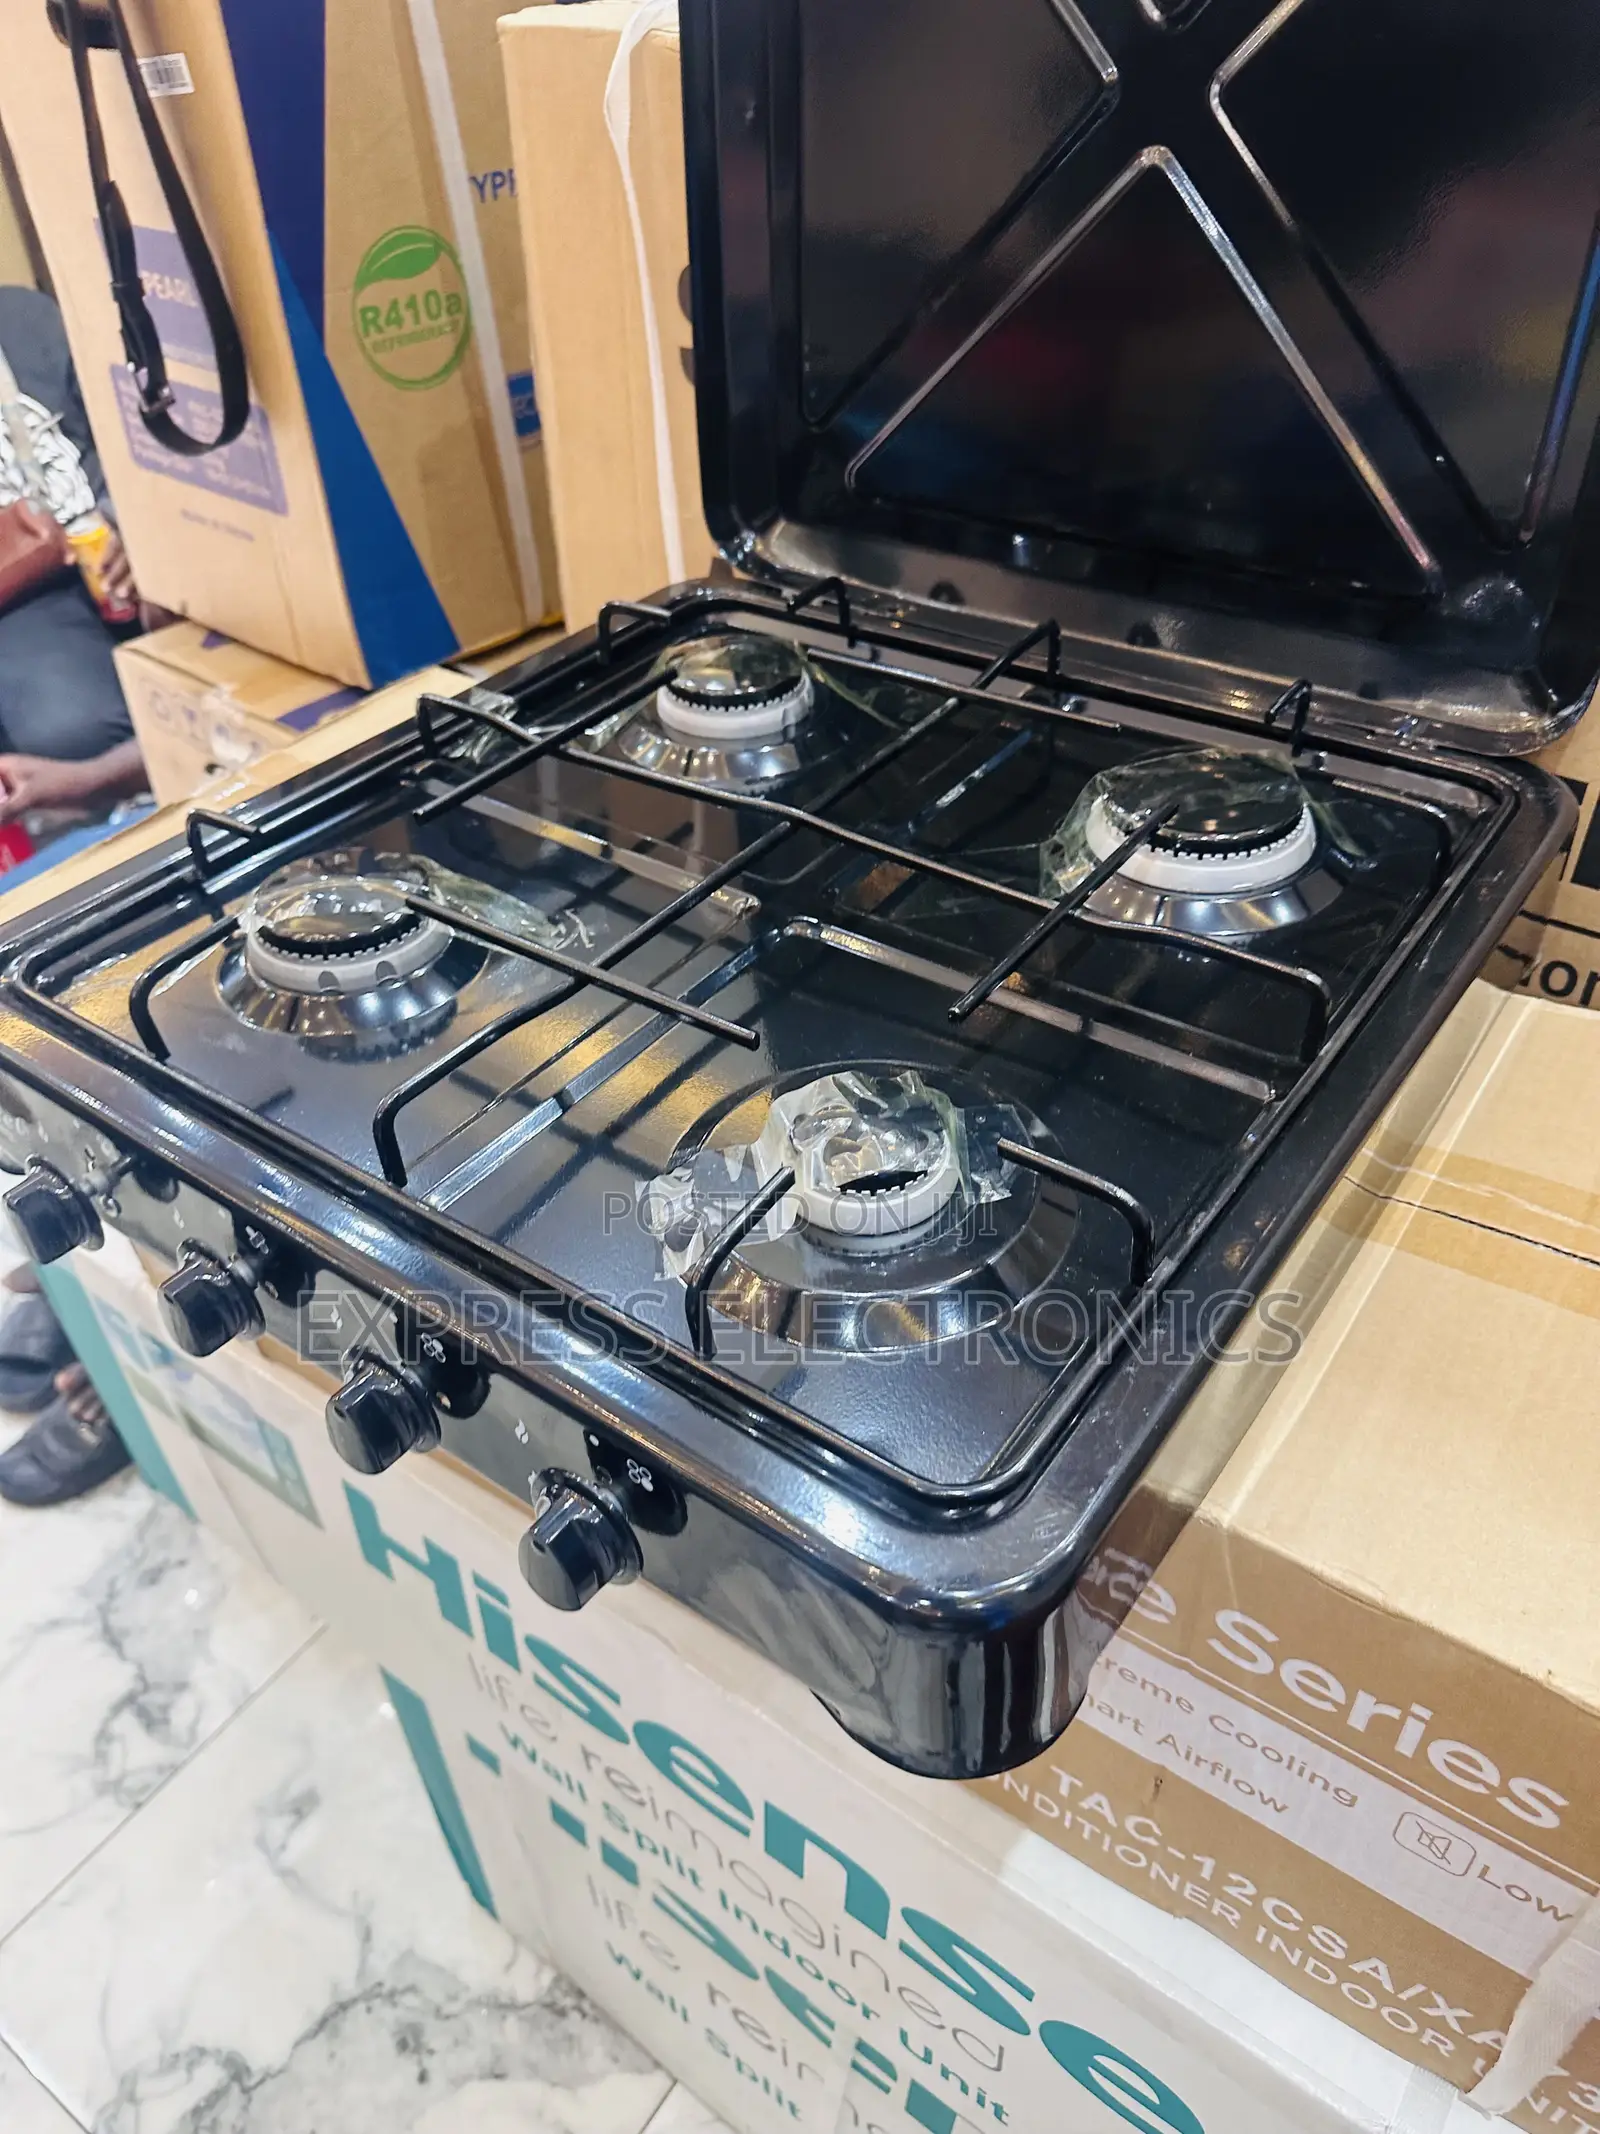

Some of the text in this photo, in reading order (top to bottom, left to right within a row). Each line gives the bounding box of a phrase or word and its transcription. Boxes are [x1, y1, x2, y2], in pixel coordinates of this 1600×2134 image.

[359, 289, 463, 338] R410a
[342, 1478, 1205, 2134] Hisense
[1085, 1693, 1289, 1813] art Airflow
[1096, 1655, 1359, 1808] reme Cooling
[1206, 1608, 1570, 1829] Series
[498, 1720, 588, 1804] Wall
[601, 1800, 704, 1892] Split
[718, 1887, 881, 2021] Indoor
[580, 1743, 1005, 2072] reimagined
[985, 1770, 1242, 1930] NDITIONER
[1254, 1924, 1457, 2058] INDOOR
[1476, 1864, 1574, 1922] Low
[604, 1939, 690, 2025] Wall
[704, 2026, 803, 2122] Split
